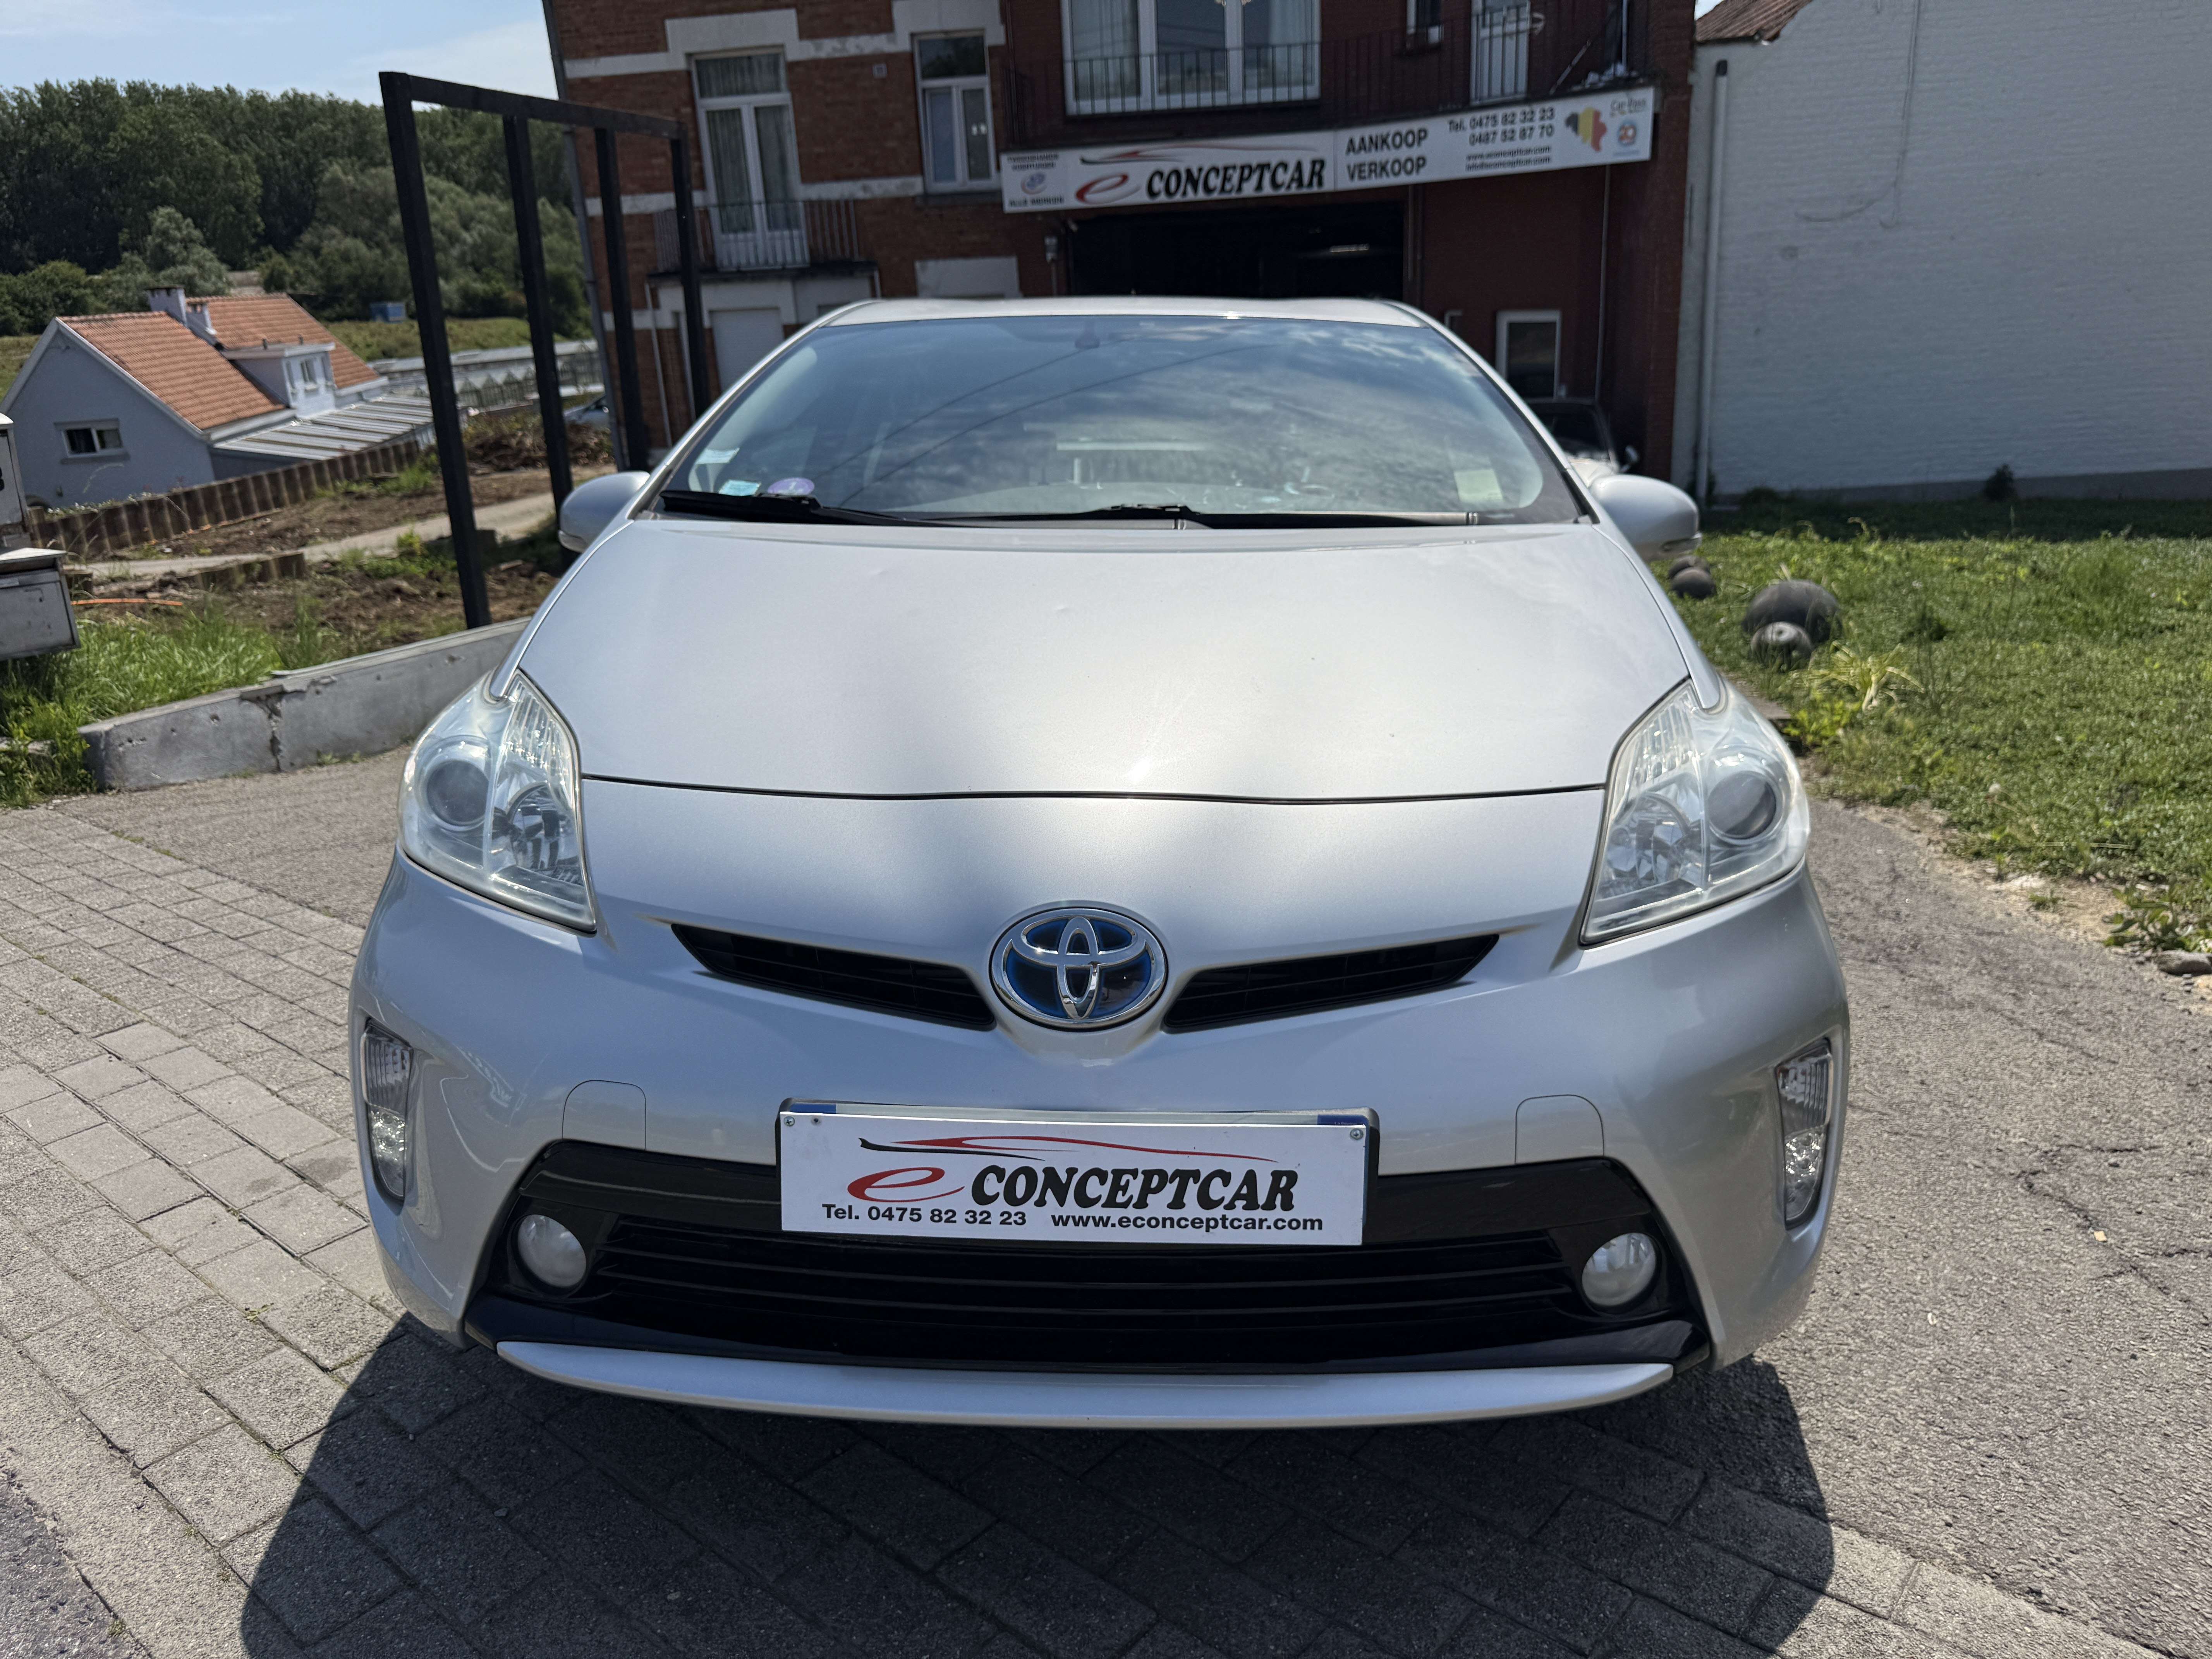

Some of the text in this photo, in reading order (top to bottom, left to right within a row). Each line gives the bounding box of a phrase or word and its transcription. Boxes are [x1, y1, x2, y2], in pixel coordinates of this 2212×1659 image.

[1448, 106, 1555, 132] Tel. 0475 82 32 23
[1539, 123, 1554, 137] 70
[1345, 127, 1428, 155] AANKOOP
[1147, 158, 1326, 199] CONCEPTCAR
[1346, 155, 1426, 182] VERKOOP
[971, 1164, 1298, 1211] CONCEPTCAR
[822, 1204, 1323, 1233] Tel. 0475 82 32 23 www.econceptcar.com
